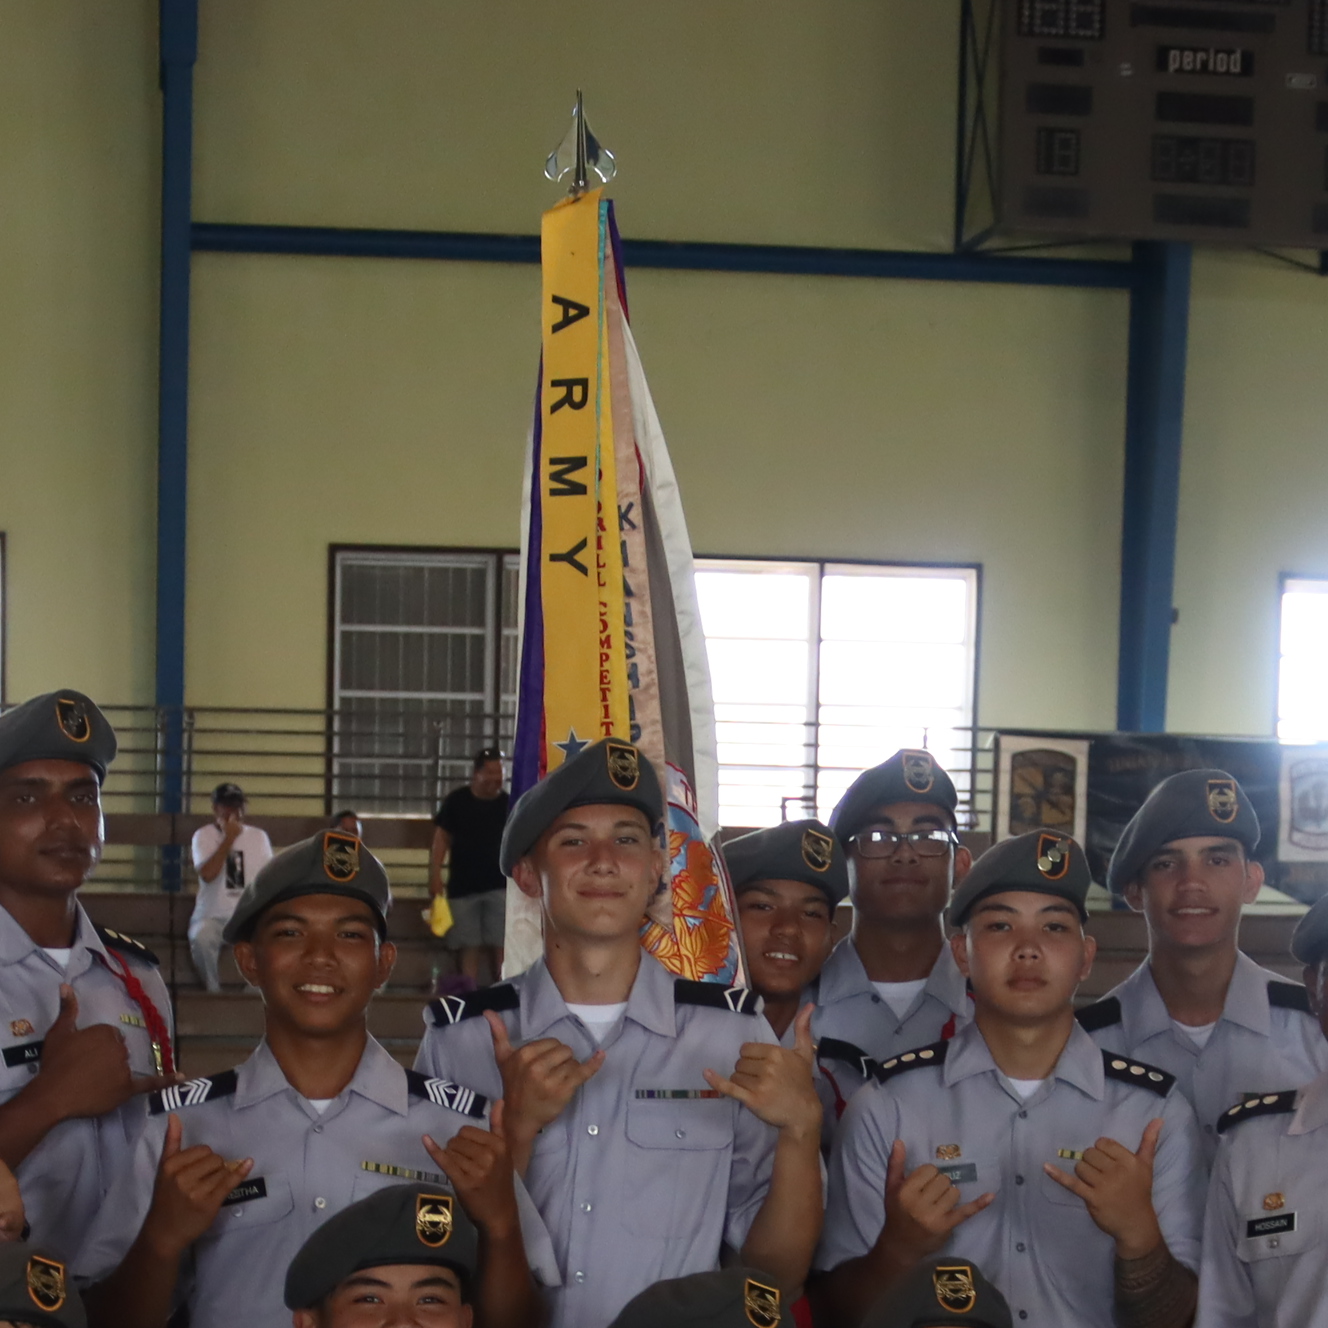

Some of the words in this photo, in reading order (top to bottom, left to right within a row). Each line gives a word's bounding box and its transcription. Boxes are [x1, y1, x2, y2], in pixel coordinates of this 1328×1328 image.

[1168, 48, 1241, 73] period
[549, 294, 590, 577] ARMY
[24, 1048, 38, 1058] ALI
[1254, 1219, 1288, 1231] HOSSAIN
